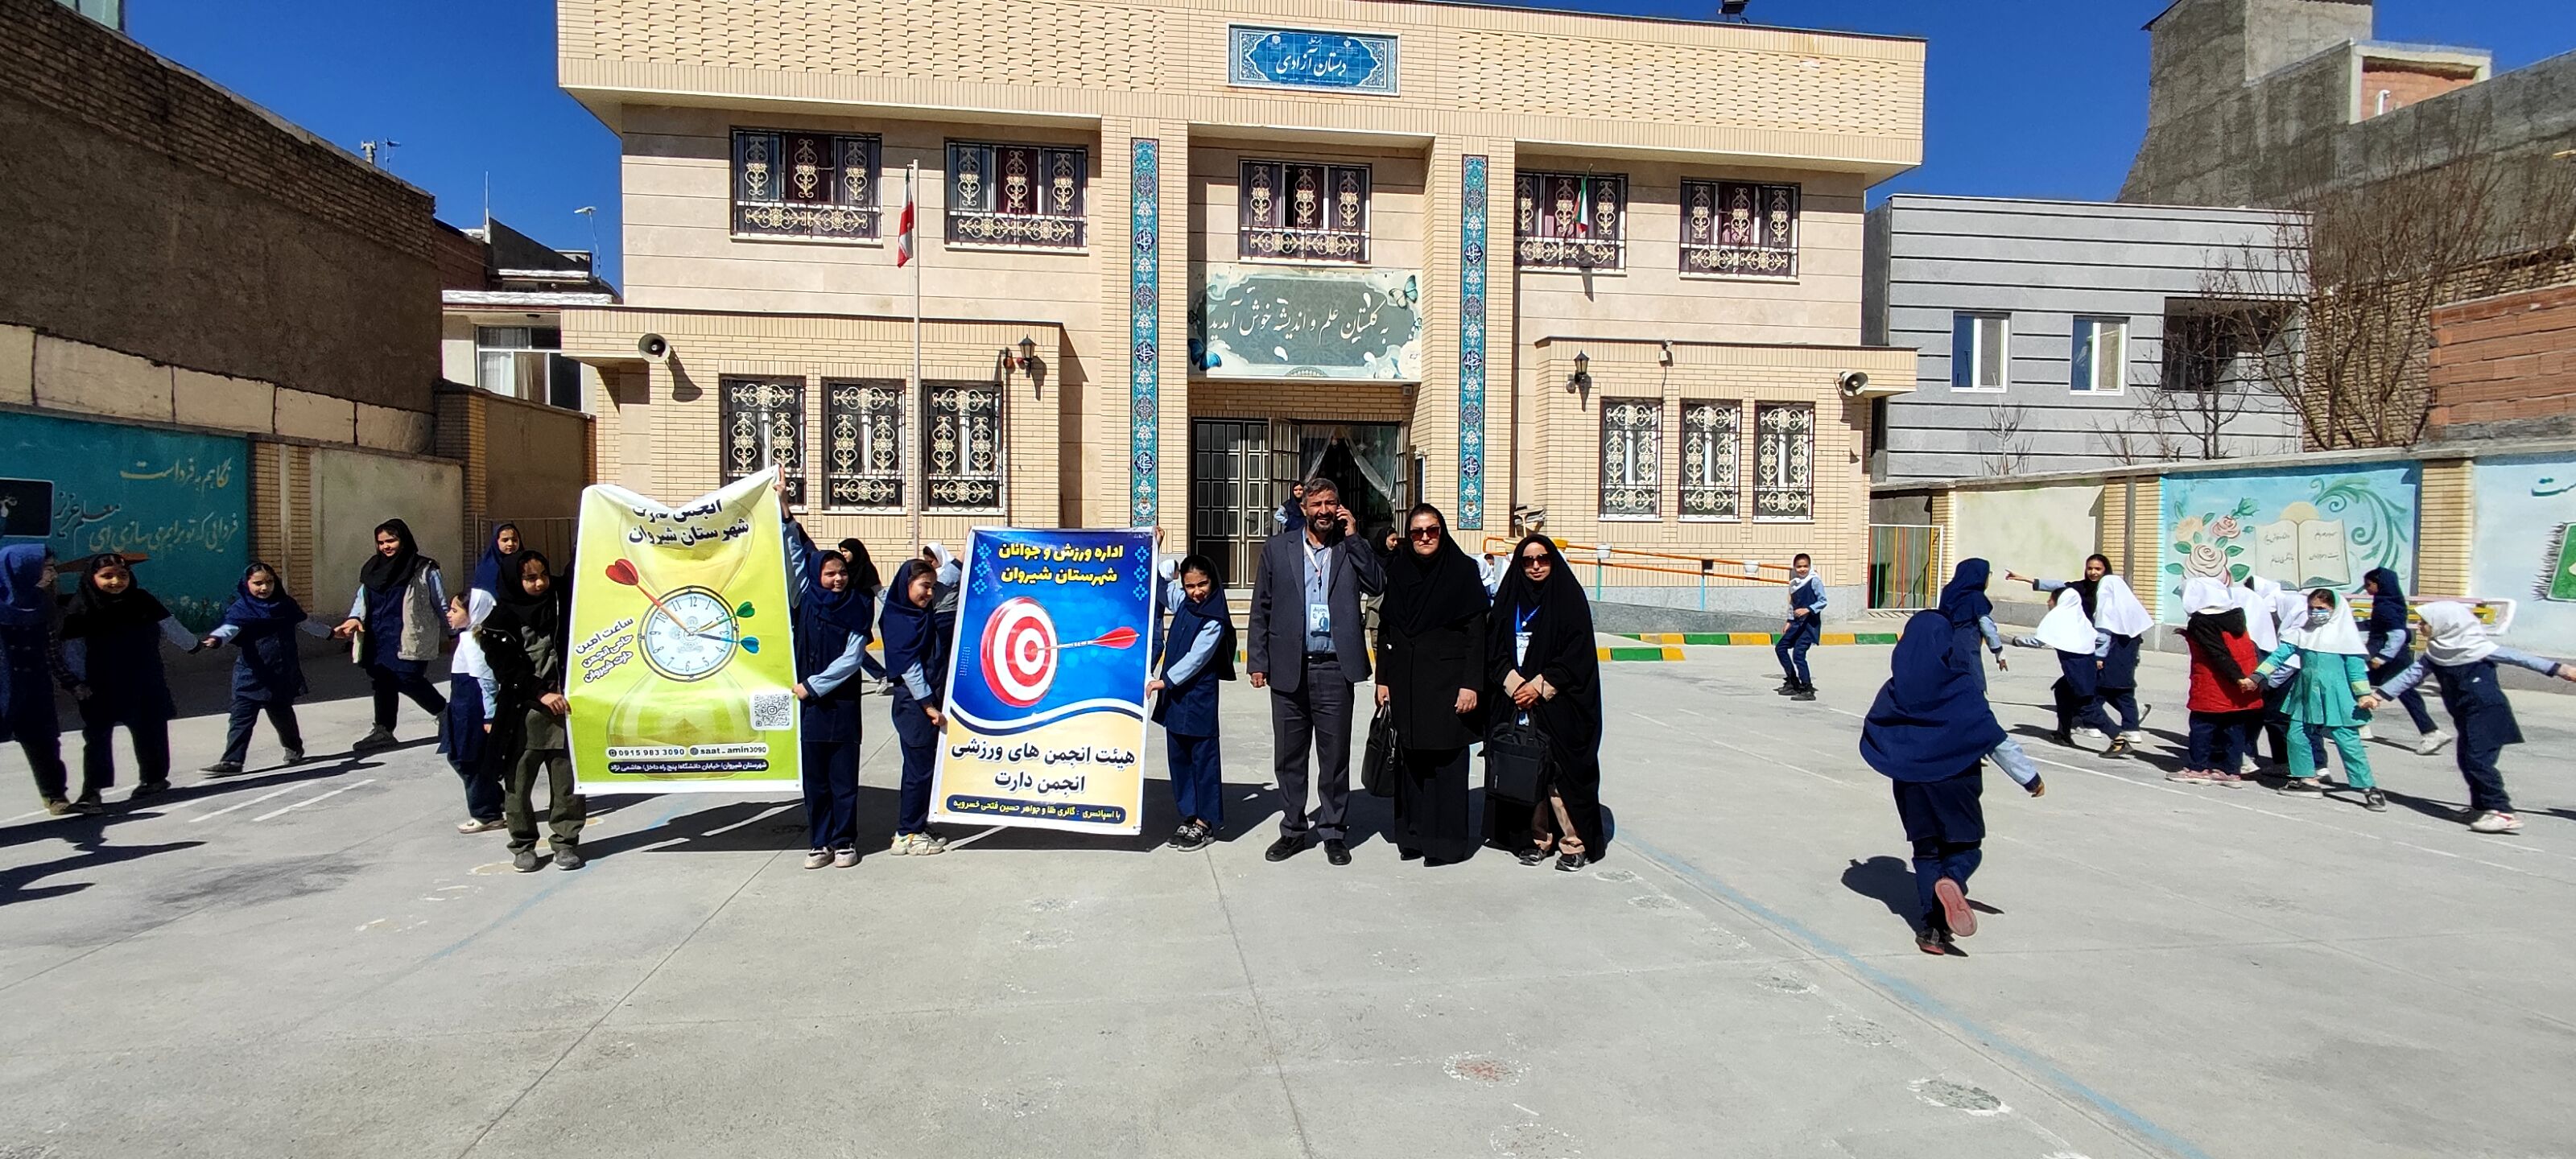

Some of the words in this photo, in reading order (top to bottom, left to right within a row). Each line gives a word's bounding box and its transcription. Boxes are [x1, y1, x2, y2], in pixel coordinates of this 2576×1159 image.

[1276, 47, 1319, 74] آزادی
[1314, 52, 1347, 76] دبستان
[1208, 298, 1244, 340] آمدید
[1239, 299, 1272, 336] خوش
[1273, 307, 1307, 340] اندیشه
[1309, 319, 1316, 332] و
[1319, 307, 1340, 344] علم
[1380, 326, 1389, 344] به
[200, 457, 232, 498] نگاهم
[629, 525, 677, 544] شیروان
[998, 542, 1041, 561] جوانان
[1043, 548, 1051, 561] و
[1054, 542, 1092, 562] ورزش
[1094, 544, 1124, 563] اداره
[1001, 566, 1052, 584] شیروان
[1055, 567, 1118, 586] شهرستان
[602, 618, 634, 637] ساعت
[576, 633, 602, 654] امین
[609, 634, 634, 654] حامی
[581, 645, 611, 668] انجمن
[613, 651, 634, 665] دارت
[584, 660, 615, 683] شیروان
[952, 738, 1002, 761] ورزشی
[1008, 742, 1039, 762] های
[1044, 746, 1092, 766] انجمن
[1096, 748, 1135, 770] هیئت
[742, 761, 767, 769] شهرستان
[994, 771, 1033, 791] دارت
[1038, 776, 1085, 795] انجمن
[980, 801, 999, 810] فتحی
[999, 803, 1020, 813] حسین
[1021, 805, 1041, 815] جواهر
[1057, 806, 1076, 817] گالری
[1082, 810, 1115, 820] اسپانسری
[1115, 810, 1121, 820] با
